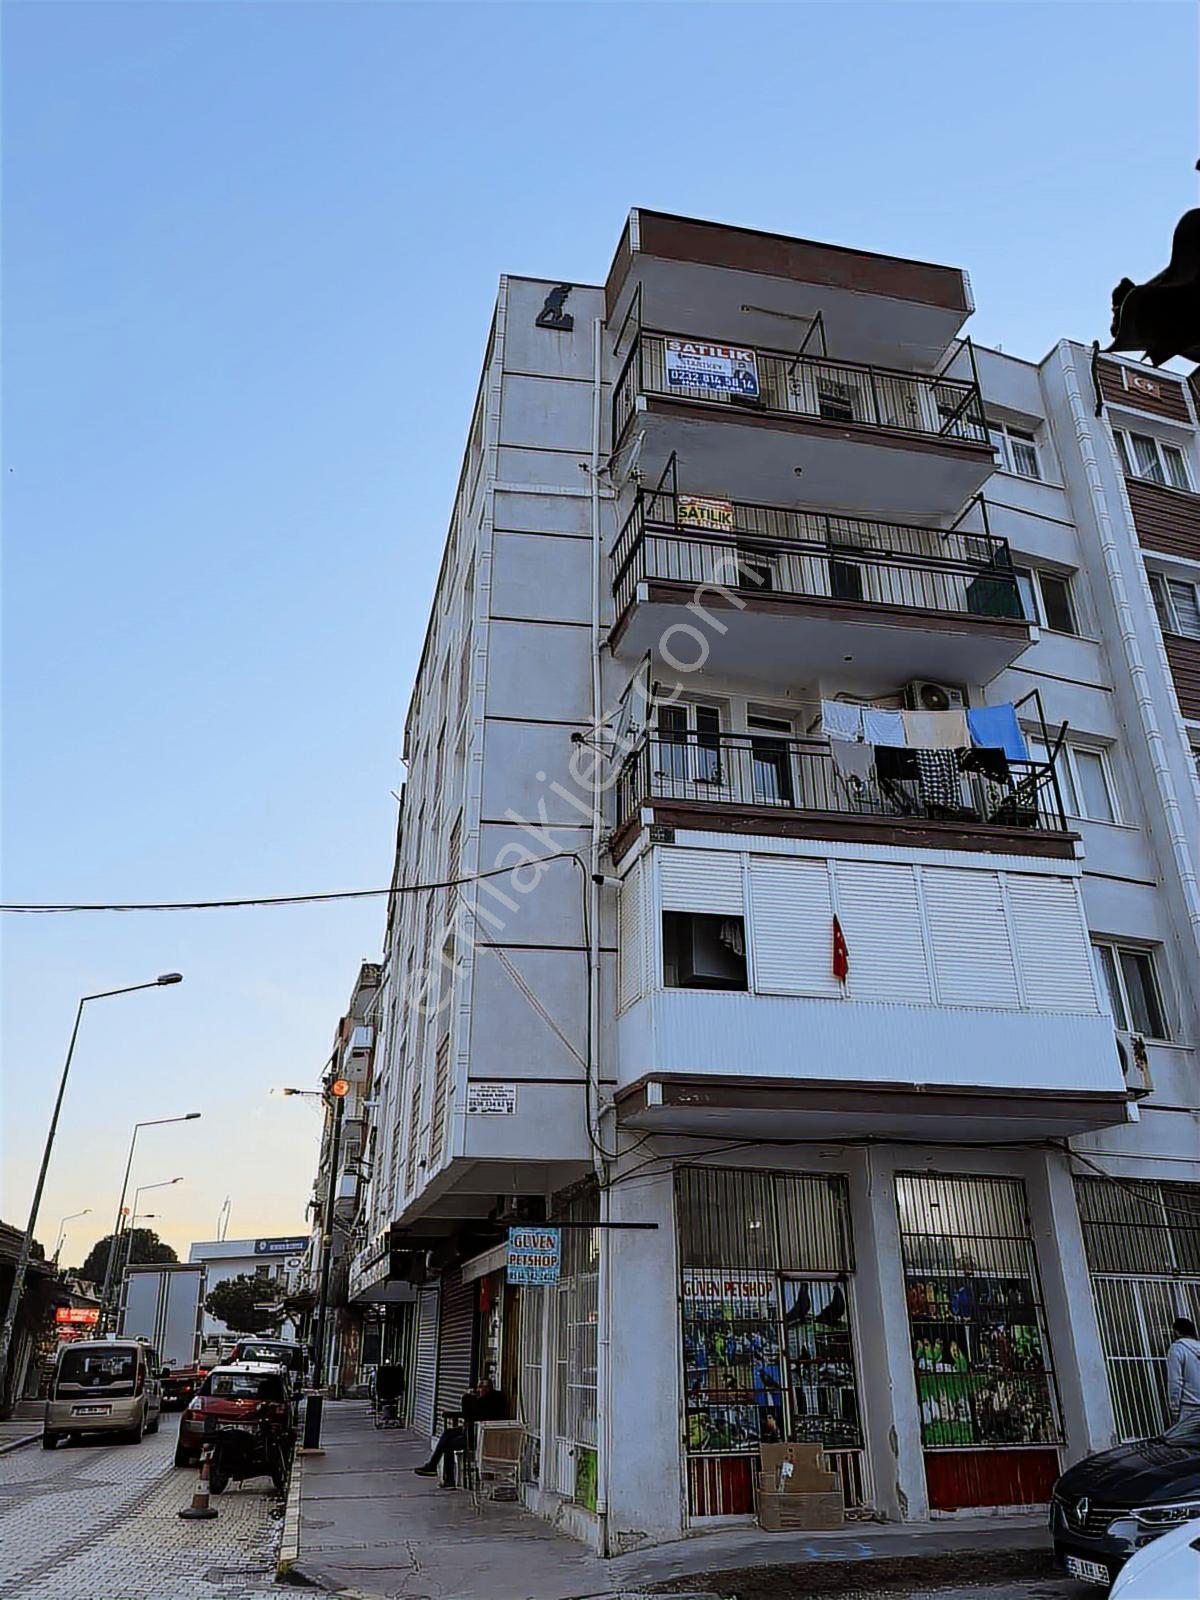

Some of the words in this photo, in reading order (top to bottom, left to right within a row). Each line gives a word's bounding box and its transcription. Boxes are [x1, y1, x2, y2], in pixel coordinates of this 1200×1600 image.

[668, 341, 752, 361] SATILIK
[671, 370, 699, 381] 0232
[742, 379, 755, 390] 14
[678, 506, 732, 524] SATILIK
[509, 1254, 558, 1267] PETSHOP
[684, 1276, 720, 1297] GÜVEN
